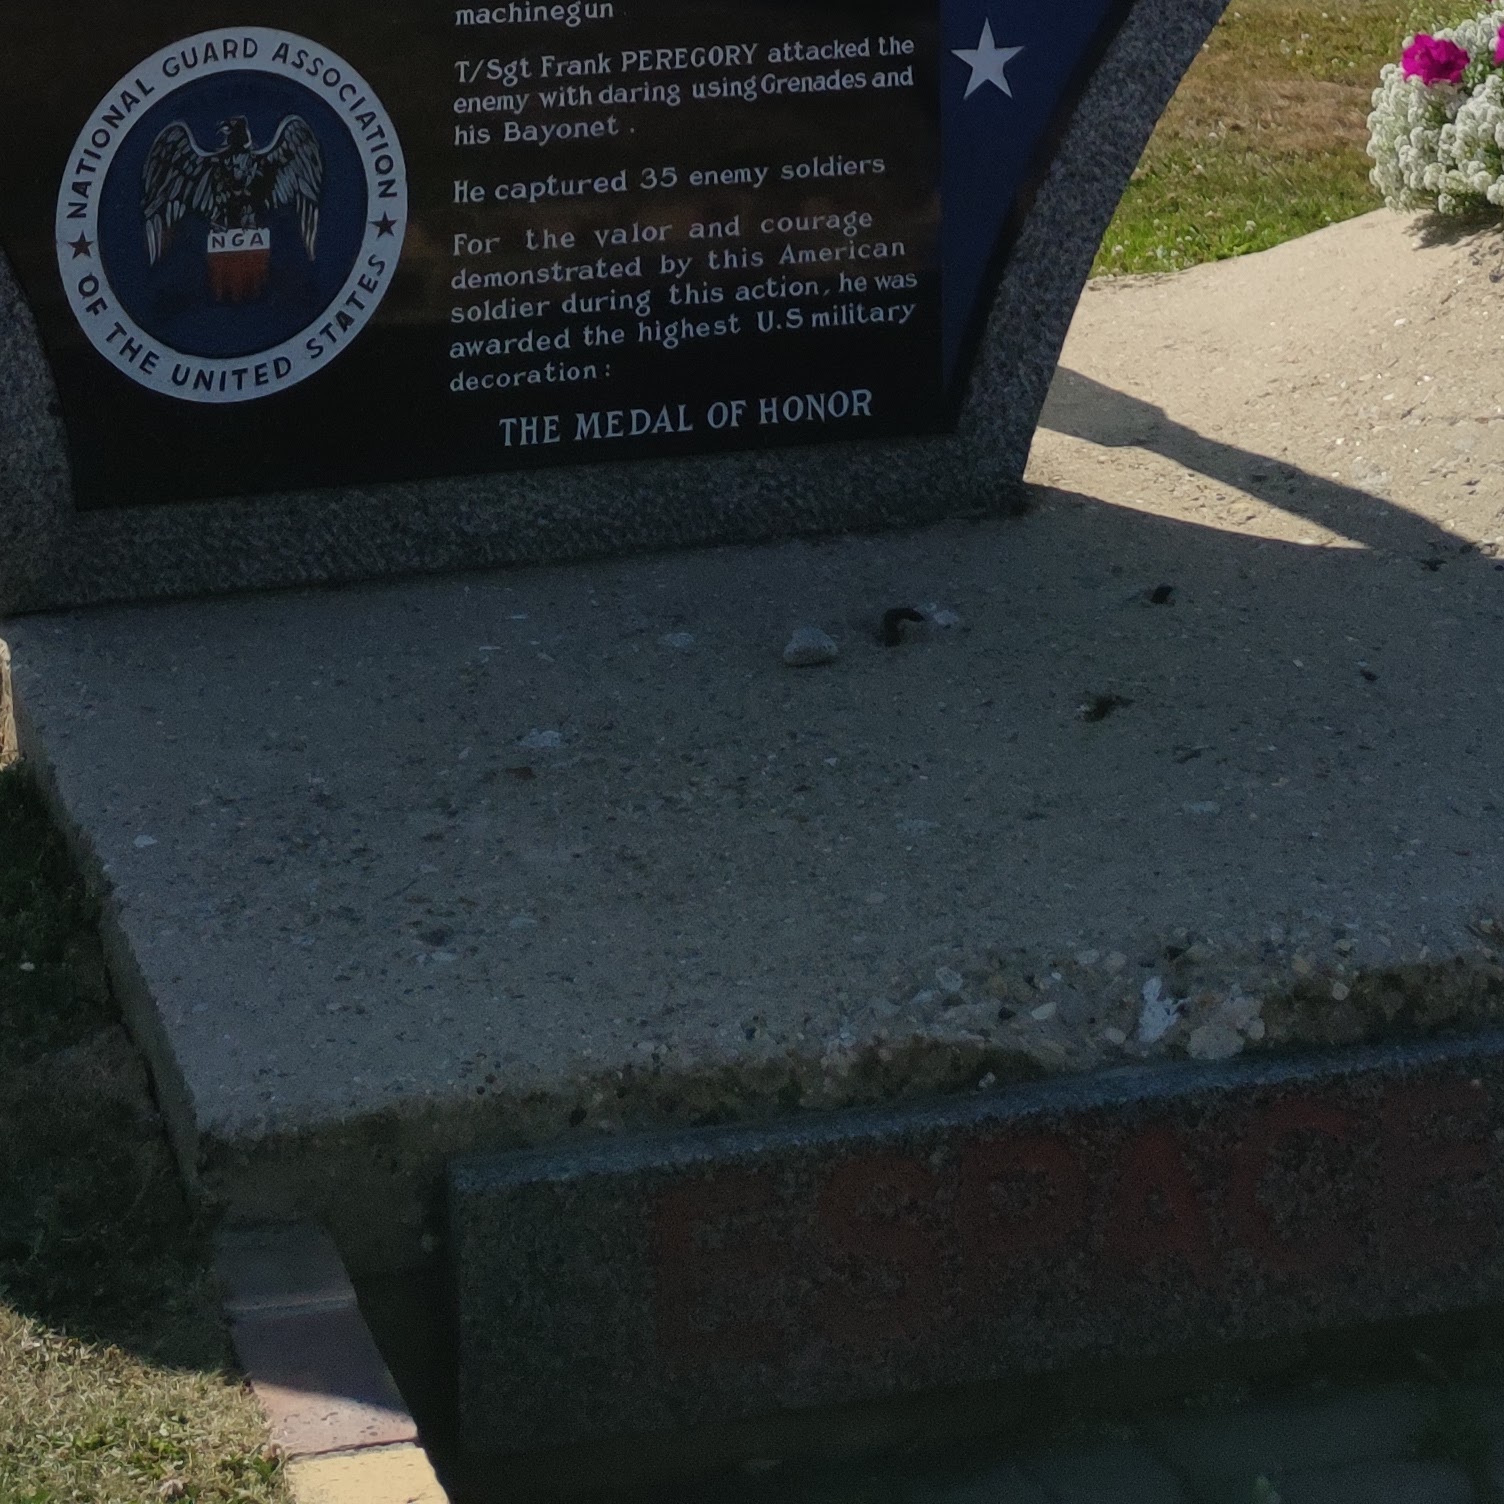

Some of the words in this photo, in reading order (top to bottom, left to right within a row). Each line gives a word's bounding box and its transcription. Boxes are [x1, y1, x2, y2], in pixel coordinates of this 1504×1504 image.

[454, 0, 614, 29] machinegun
[453, 56, 533, 88] T/Sgt
[539, 51, 612, 79] Frank
[620, 42, 759, 73] PEREGORY
[767, 36, 871, 64] attacked
[877, 35, 915, 57] the
[452, 92, 531, 116] enemy
[537, 84, 594, 109] with
[597, 80, 682, 108] daring
[691, 74, 758, 103] using
[759, 68, 868, 95] Grenades
[870, 64, 915, 89] and
[66, 76, 156, 220] NATIONAL
[161, 37, 259, 79] GUARD
[270, 41, 399, 199] ASSOCIATION
[453, 123, 492, 147] his
[452, 179, 486, 204] He
[494, 168, 628, 204] captured
[639, 166, 679, 190] 35
[688, 166, 769, 189] enemy
[780, 154, 886, 181] soldiers
[210, 232, 265, 249] NGA
[452, 232, 501, 257] For
[525, 228, 576, 251] the
[593, 221, 673, 248] valor
[688, 214, 741, 239] and
[759, 210, 873, 239] courage
[450, 255, 643, 291] demonstrated
[659, 253, 693, 280] by
[707, 246, 765, 271] this
[778, 239, 906, 266] American
[76, 272, 109, 317] OF
[104, 320, 161, 376] THE
[171, 355, 293, 392] UNITED
[305, 253, 387, 360] STATES
[450, 296, 551, 324] soldier
[561, 288, 652, 318] during
[668, 282, 725, 306] this
[734, 274, 831, 302] action,
[838, 270, 868, 293] he
[873, 272, 919, 291] was
[448, 326, 571, 360] awarded
[582, 324, 626, 347] the
[637, 312, 742, 350] highest
[756, 307, 804, 333] U.S
[811, 302, 916, 328] military
[498, 414, 561, 447] THE
[573, 403, 694, 442] MEDAL
[706, 399, 748, 430] OF
[758, 388, 873, 425] HONOR
[656, 1078, 1490, 1363] ESPACE
